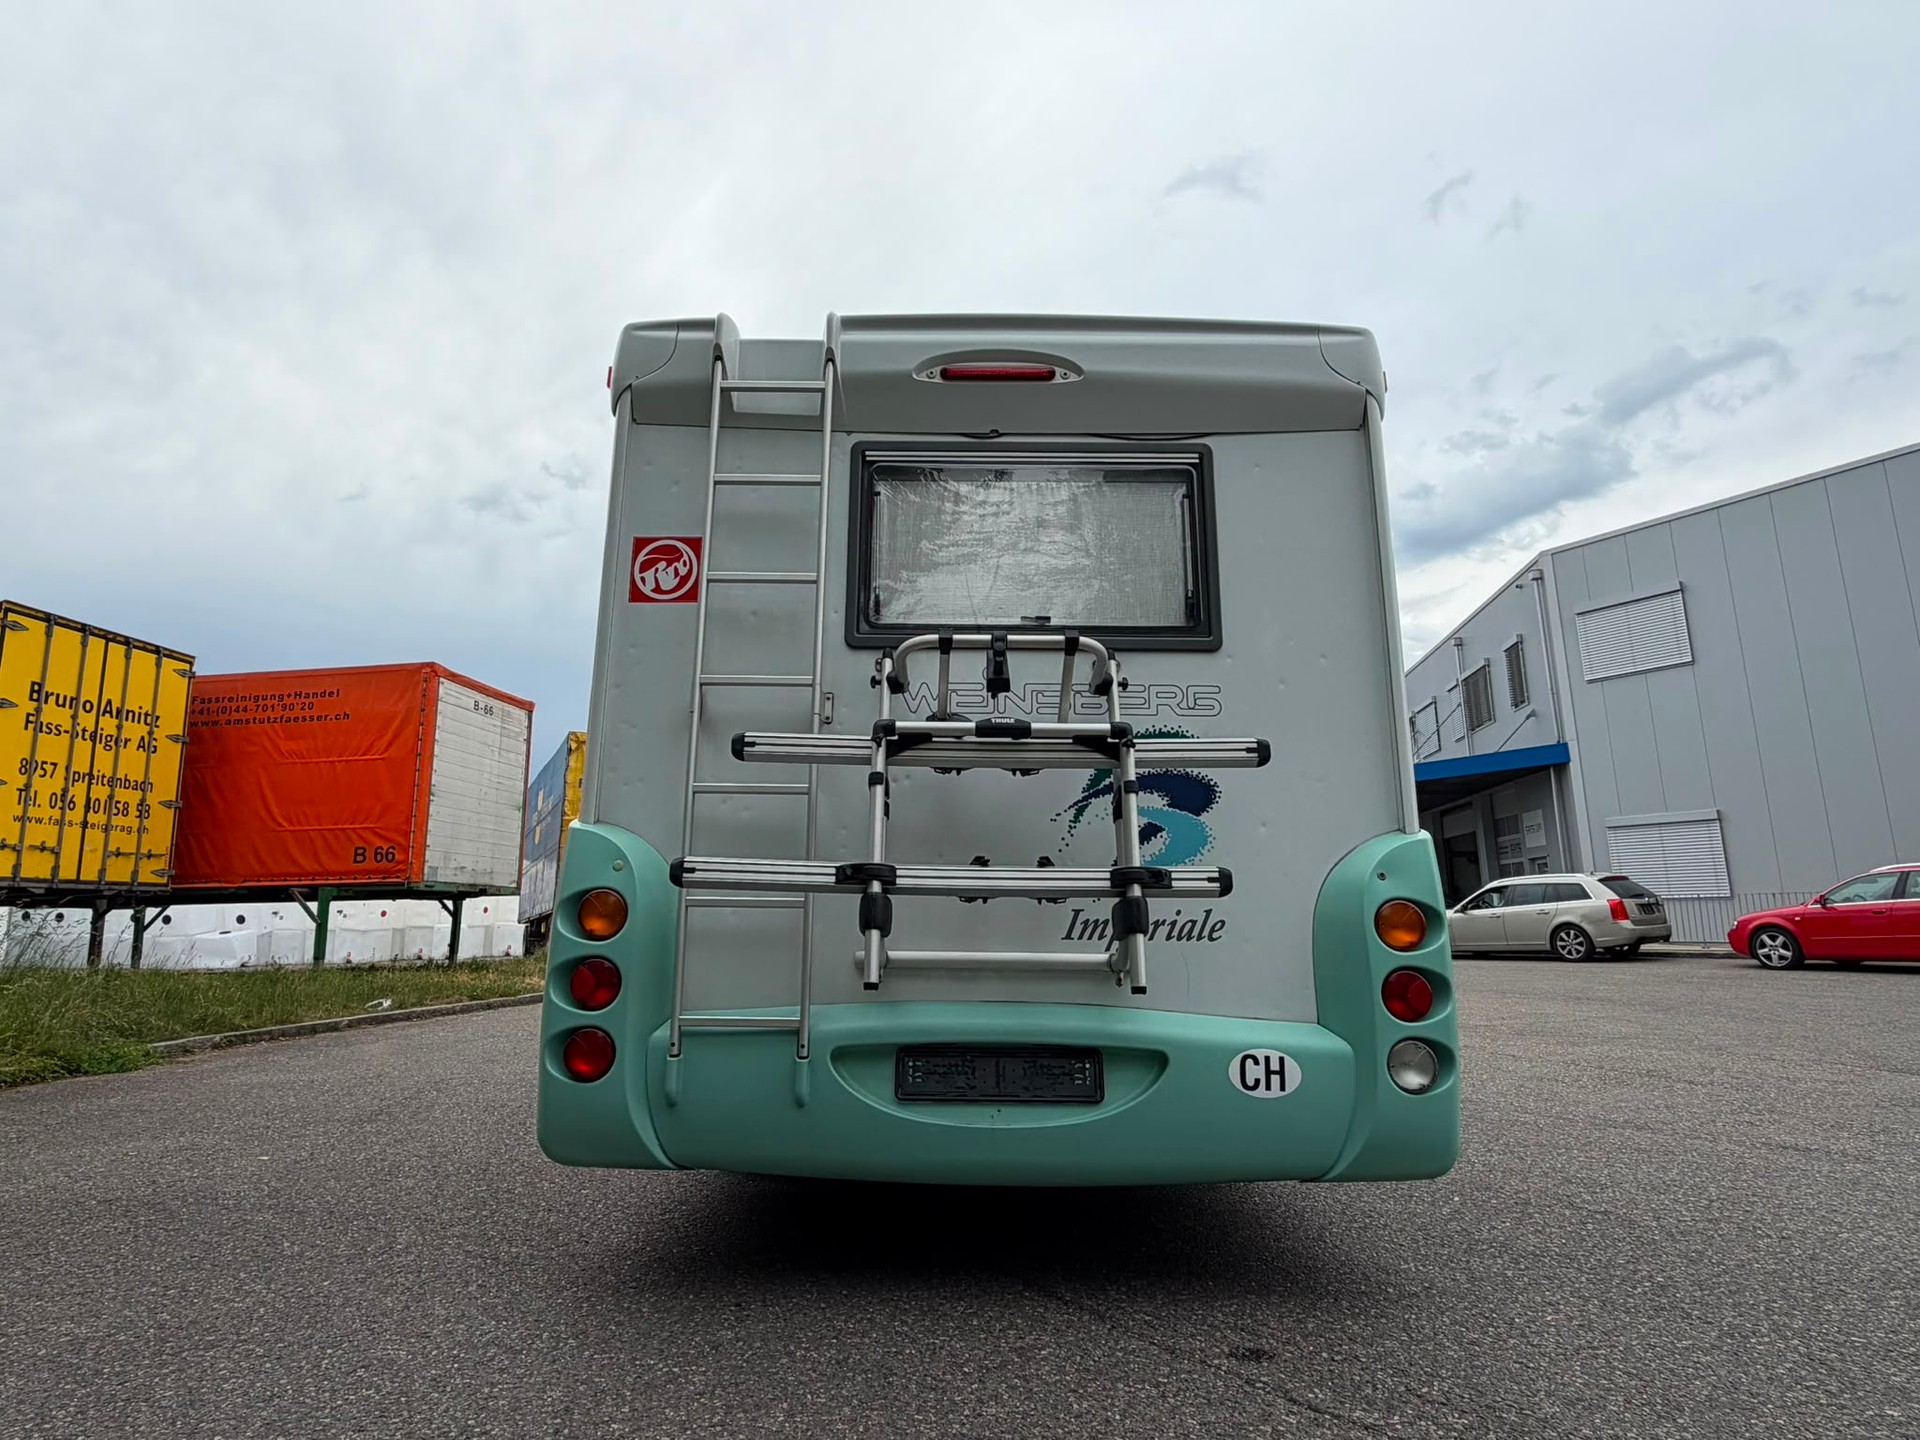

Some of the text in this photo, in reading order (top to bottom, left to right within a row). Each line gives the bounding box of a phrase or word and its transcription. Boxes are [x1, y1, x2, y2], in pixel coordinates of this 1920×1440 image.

[28, 681, 95, 714] Bruno
[191, 689, 340, 705] Fassreinigung+Handel
[473, 700, 494, 716] B-66
[189, 712, 351, 728] www.amstutzfaesser.ch
[112, 800, 130, 818] 58
[353, 846, 397, 864] B 66
[1061, 908, 1227, 953] Imriale
[1238, 1053, 1287, 1093] CH
